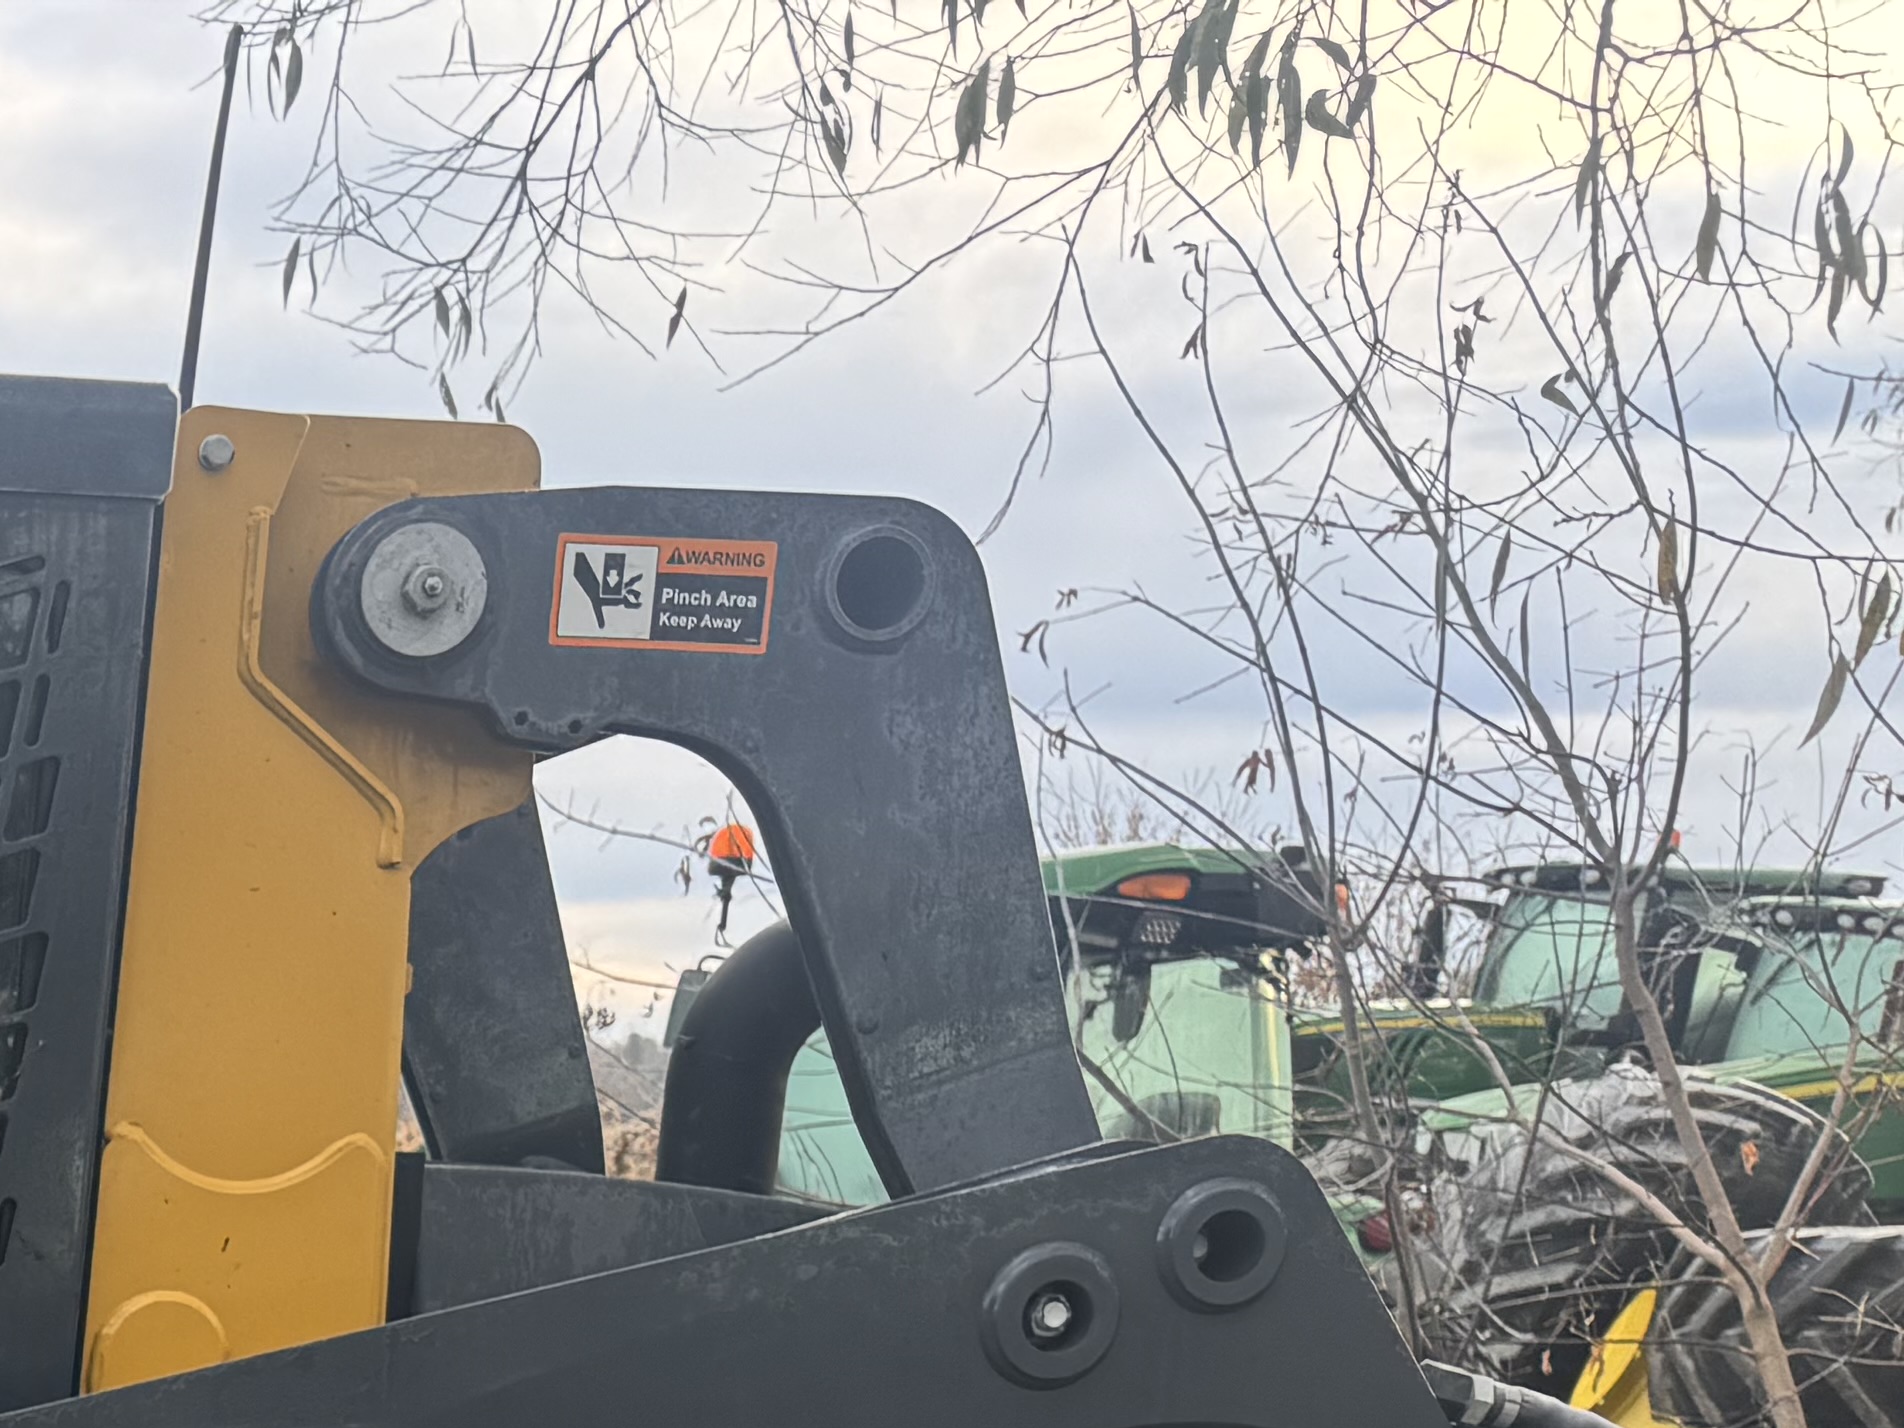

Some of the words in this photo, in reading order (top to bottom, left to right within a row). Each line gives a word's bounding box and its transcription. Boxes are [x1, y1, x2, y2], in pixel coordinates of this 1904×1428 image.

[686, 551, 766, 568] WARNING
[661, 588, 712, 606] Pinch
[716, 590, 758, 608] Area
[659, 612, 698, 630] Keep
[700, 614, 742, 632] Away
